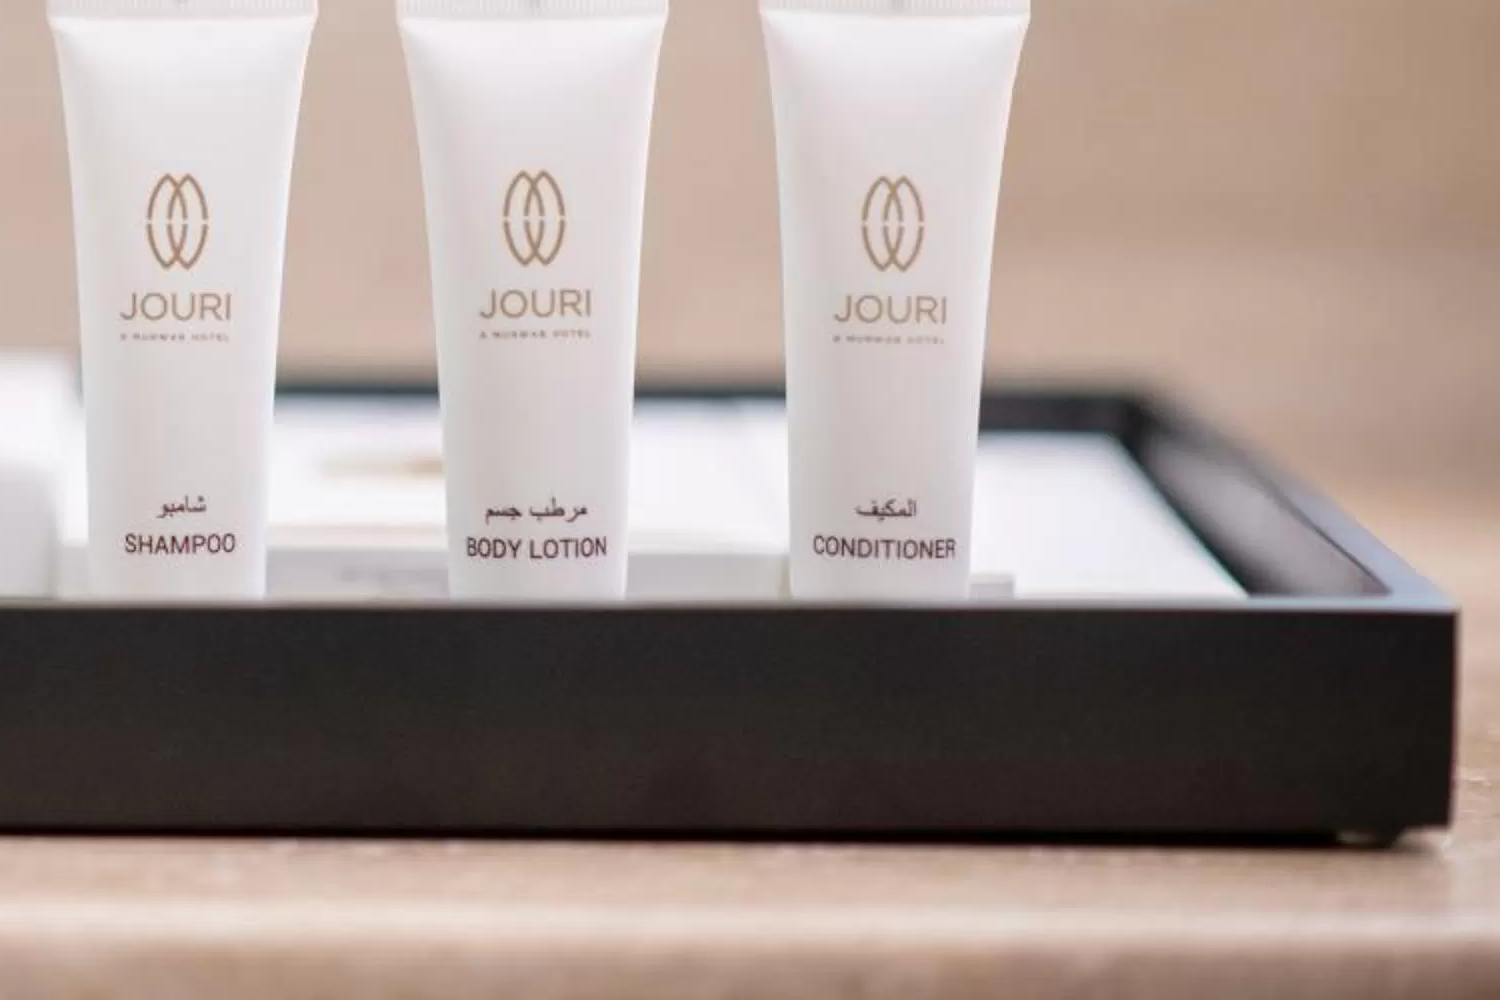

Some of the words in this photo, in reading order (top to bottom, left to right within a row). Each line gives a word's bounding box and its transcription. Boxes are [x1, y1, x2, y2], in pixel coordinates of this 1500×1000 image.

[119, 291, 233, 322] JOURI
[479, 288, 592, 320] JOURI
[833, 294, 948, 325] JOURI
[154, 494, 209, 519] شامبو
[484, 504, 523, 525] جسم
[529, 496, 589, 524] مرطب
[124, 532, 237, 555] SHAMPOO
[465, 535, 523, 560] BODY
[529, 535, 607, 560] LOTION
[812, 534, 957, 560] CONDITIONER
